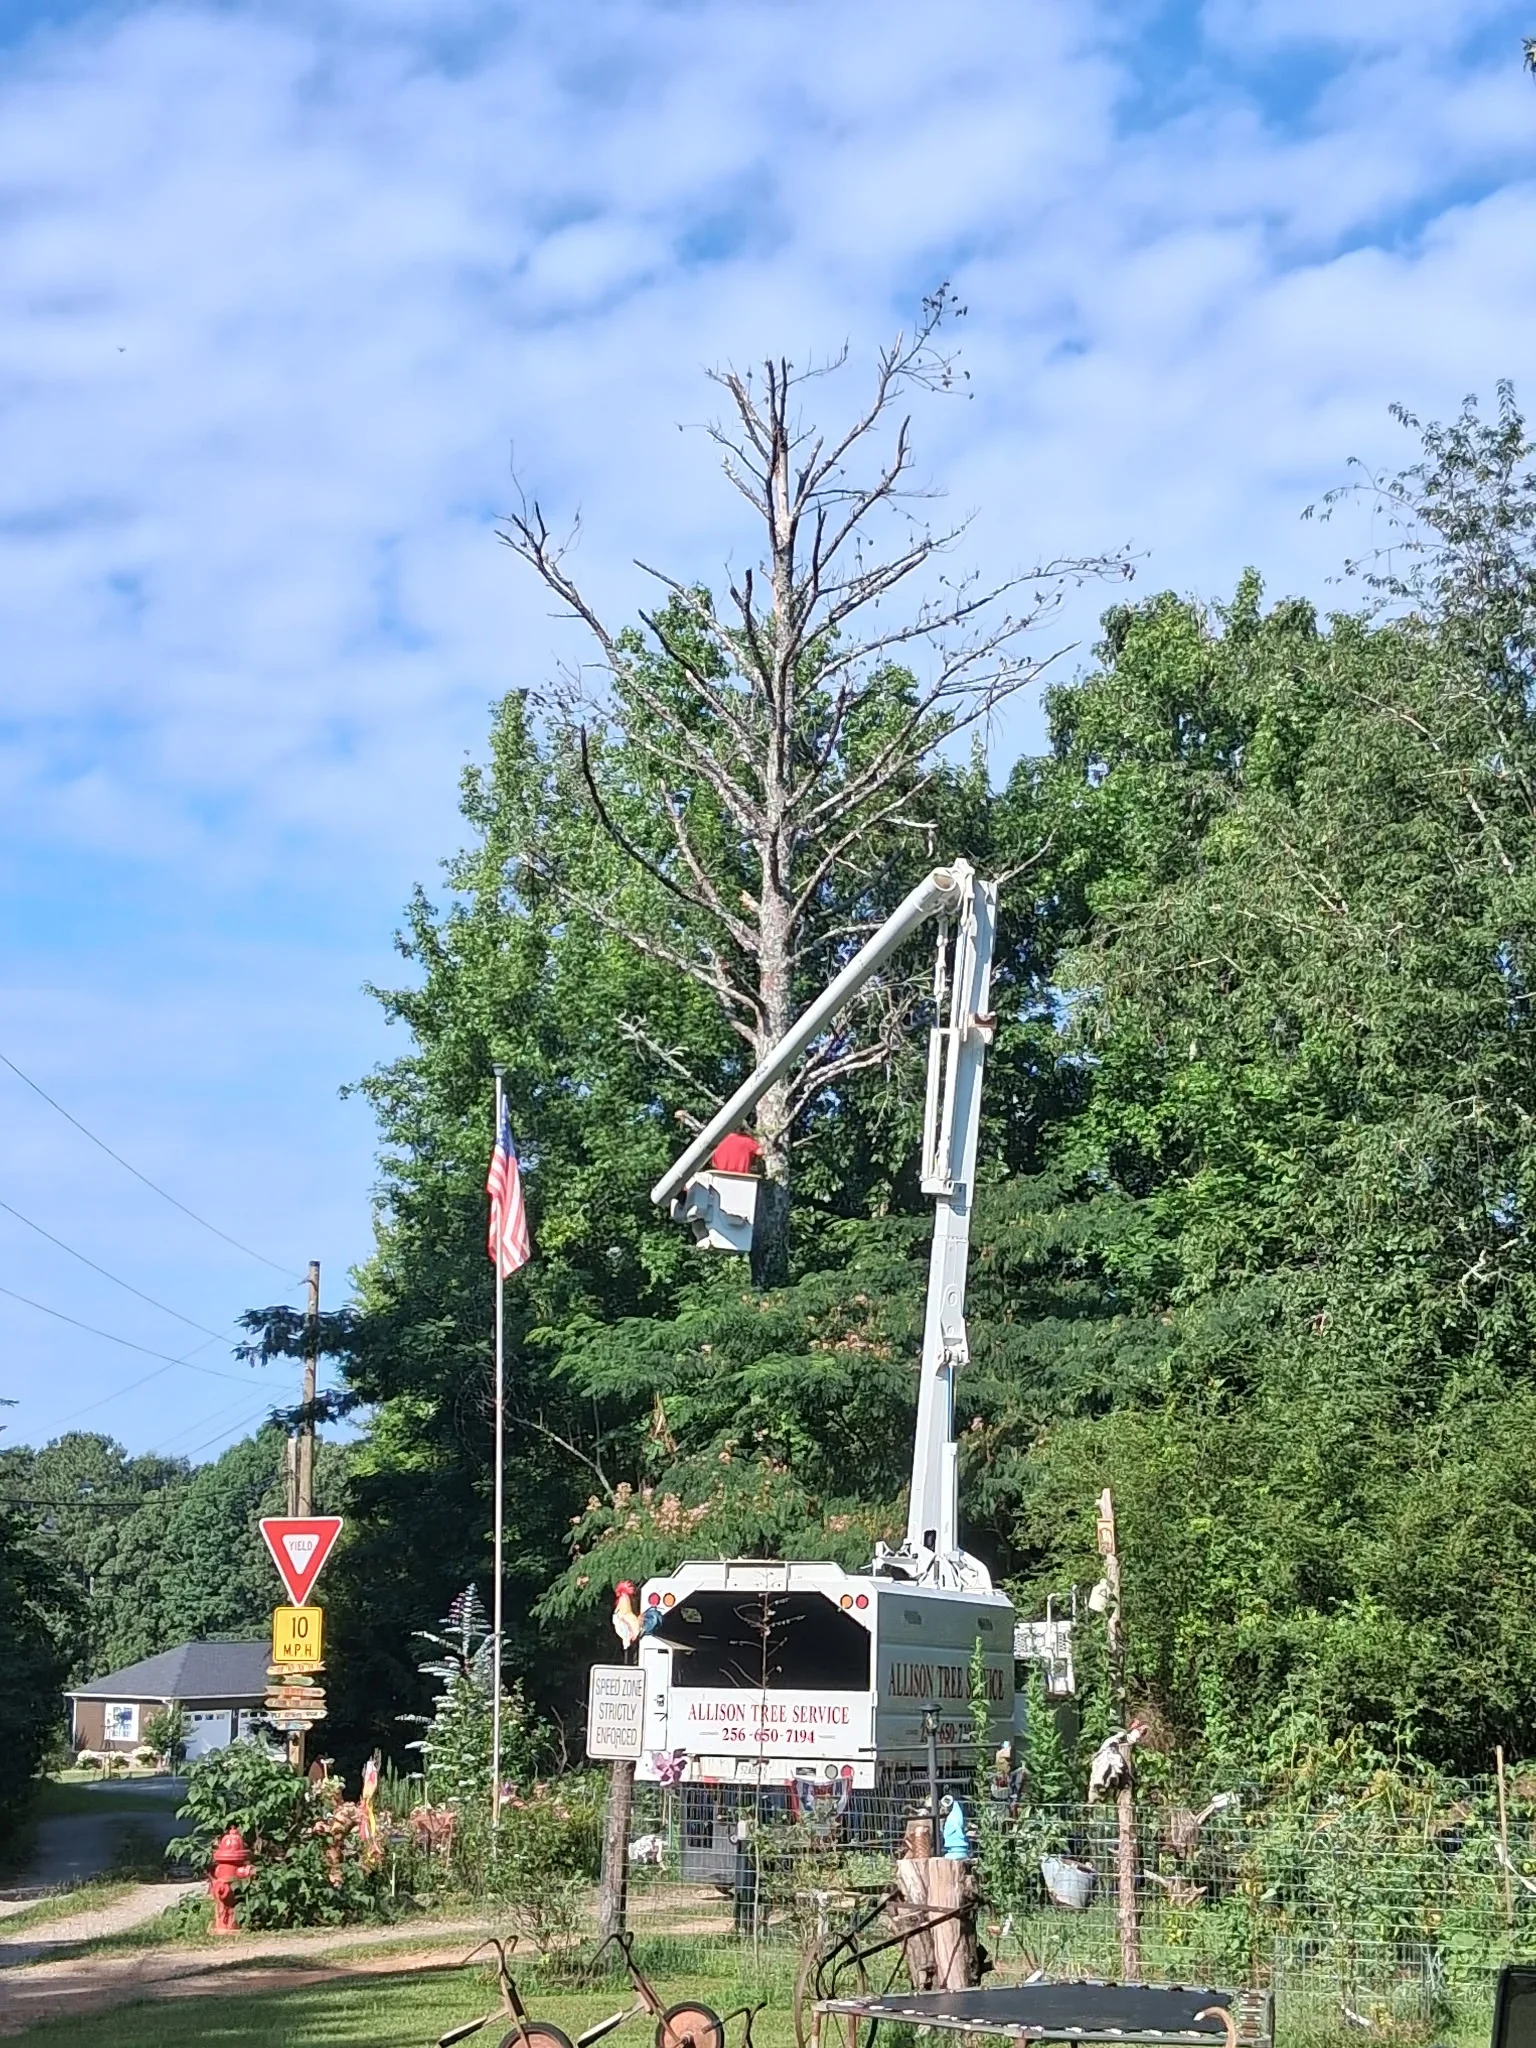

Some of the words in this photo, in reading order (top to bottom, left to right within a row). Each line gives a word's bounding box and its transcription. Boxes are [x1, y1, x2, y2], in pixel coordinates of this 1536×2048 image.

[289, 1540, 313, 1551] YIELD
[292, 1616, 308, 1638] 10
[595, 1678, 620, 1696] SPEED
[622, 1679, 642, 1697] ZONE
[888, 1662, 934, 1698] ALLISON
[937, 1666, 963, 1699] TREE
[599, 1702, 637, 1721] STRICTLY
[688, 1703, 746, 1722] ALLISON
[751, 1704, 787, 1723] TREE
[792, 1705, 850, 1725] SERVICE
[596, 1726, 638, 1746] ENFORCED
